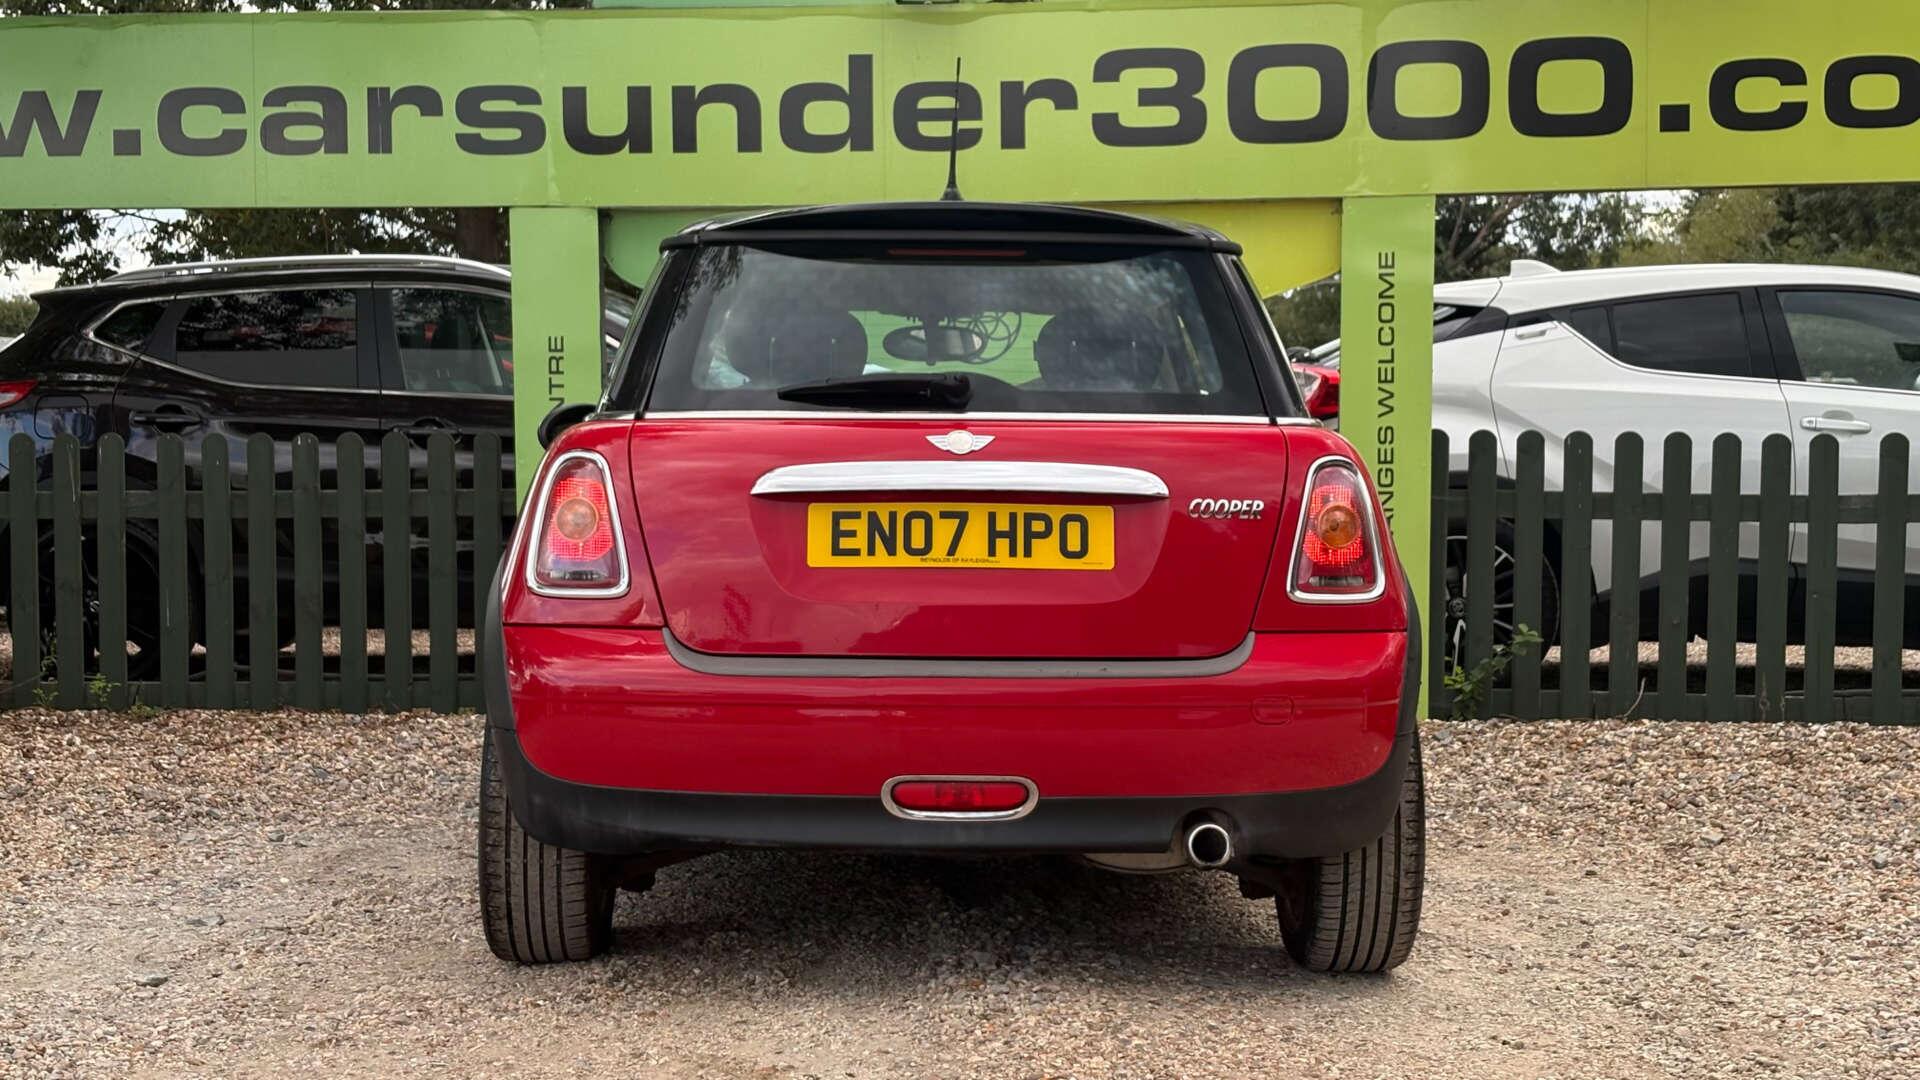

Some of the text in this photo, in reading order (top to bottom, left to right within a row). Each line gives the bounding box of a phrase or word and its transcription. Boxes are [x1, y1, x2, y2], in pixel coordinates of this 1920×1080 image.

[1378, 251, 1395, 418] WELCOME
[1188, 497, 1265, 520] COOPER
[831, 510, 1090, 559] EN07 HPO
